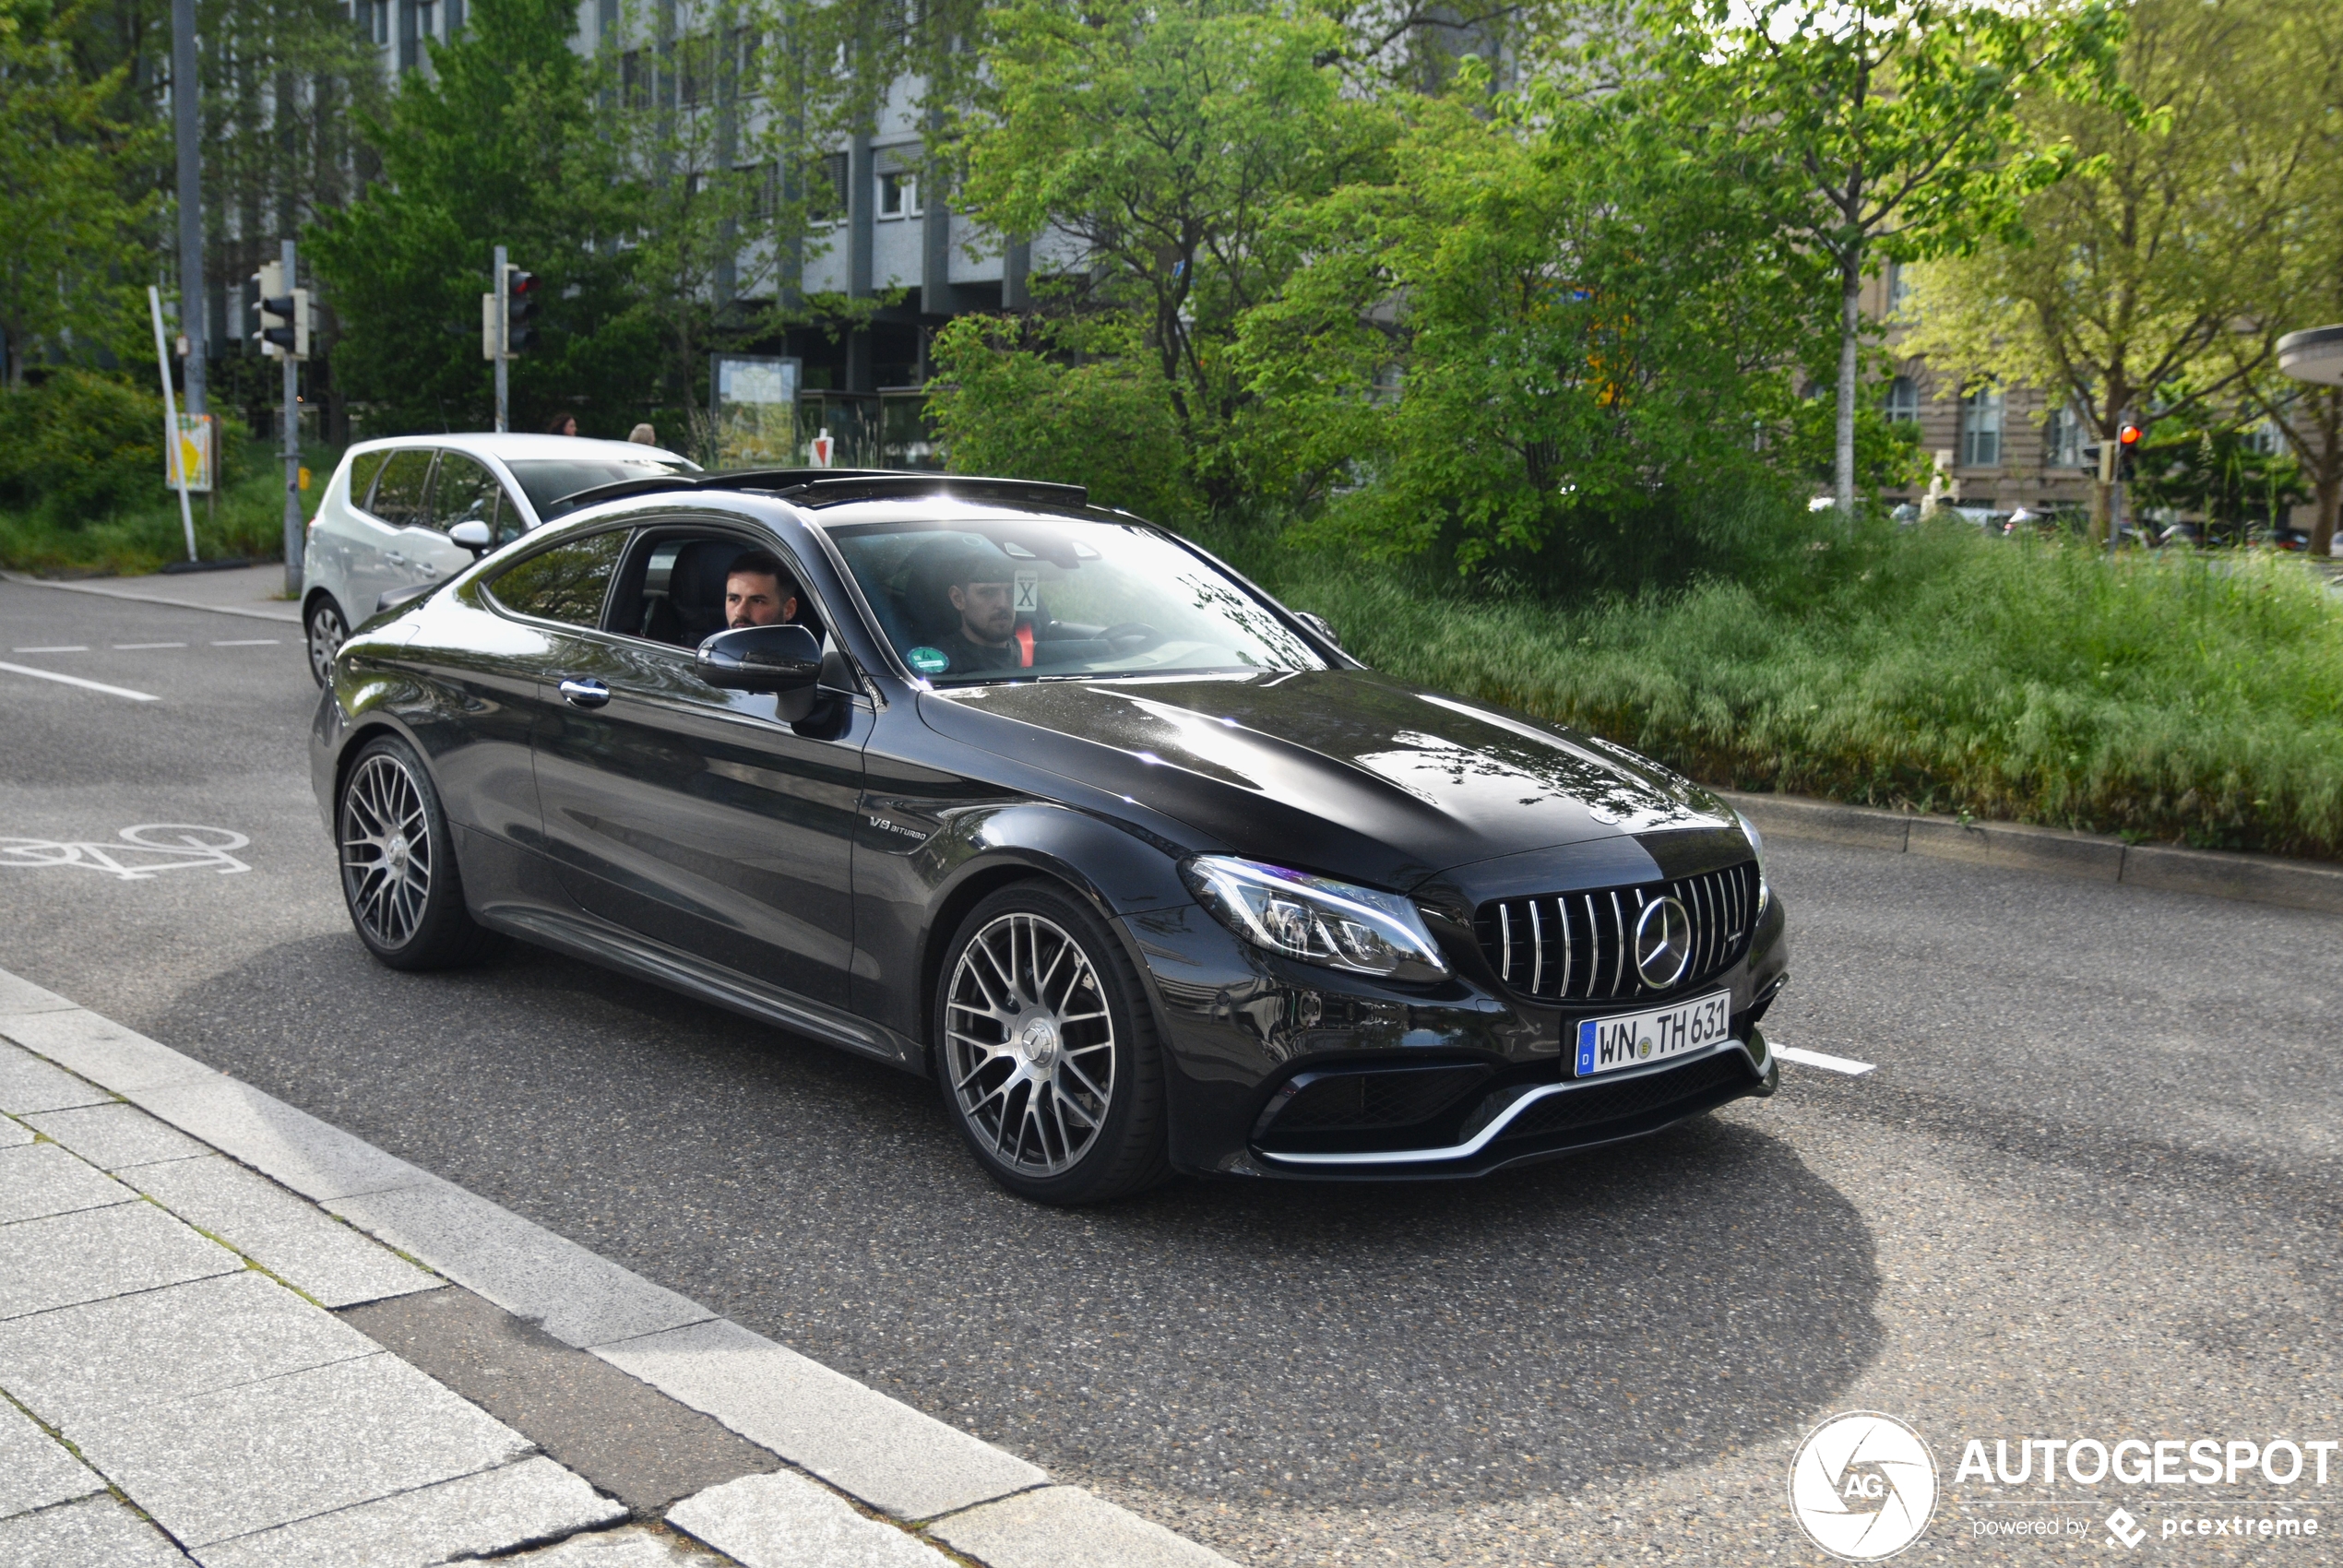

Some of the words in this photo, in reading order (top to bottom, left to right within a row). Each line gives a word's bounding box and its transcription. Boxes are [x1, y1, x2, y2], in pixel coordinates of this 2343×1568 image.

[1017, 582, 1035, 607] X
[922, 650, 933, 660] 4
[870, 816, 891, 830] V8
[891, 825, 926, 840] BITURBO
[1600, 1020, 1637, 1065] WN
[1657, 1010, 1687, 1053] TH
[1691, 999, 1727, 1044] 631
[1582, 1053, 1589, 1065] D
